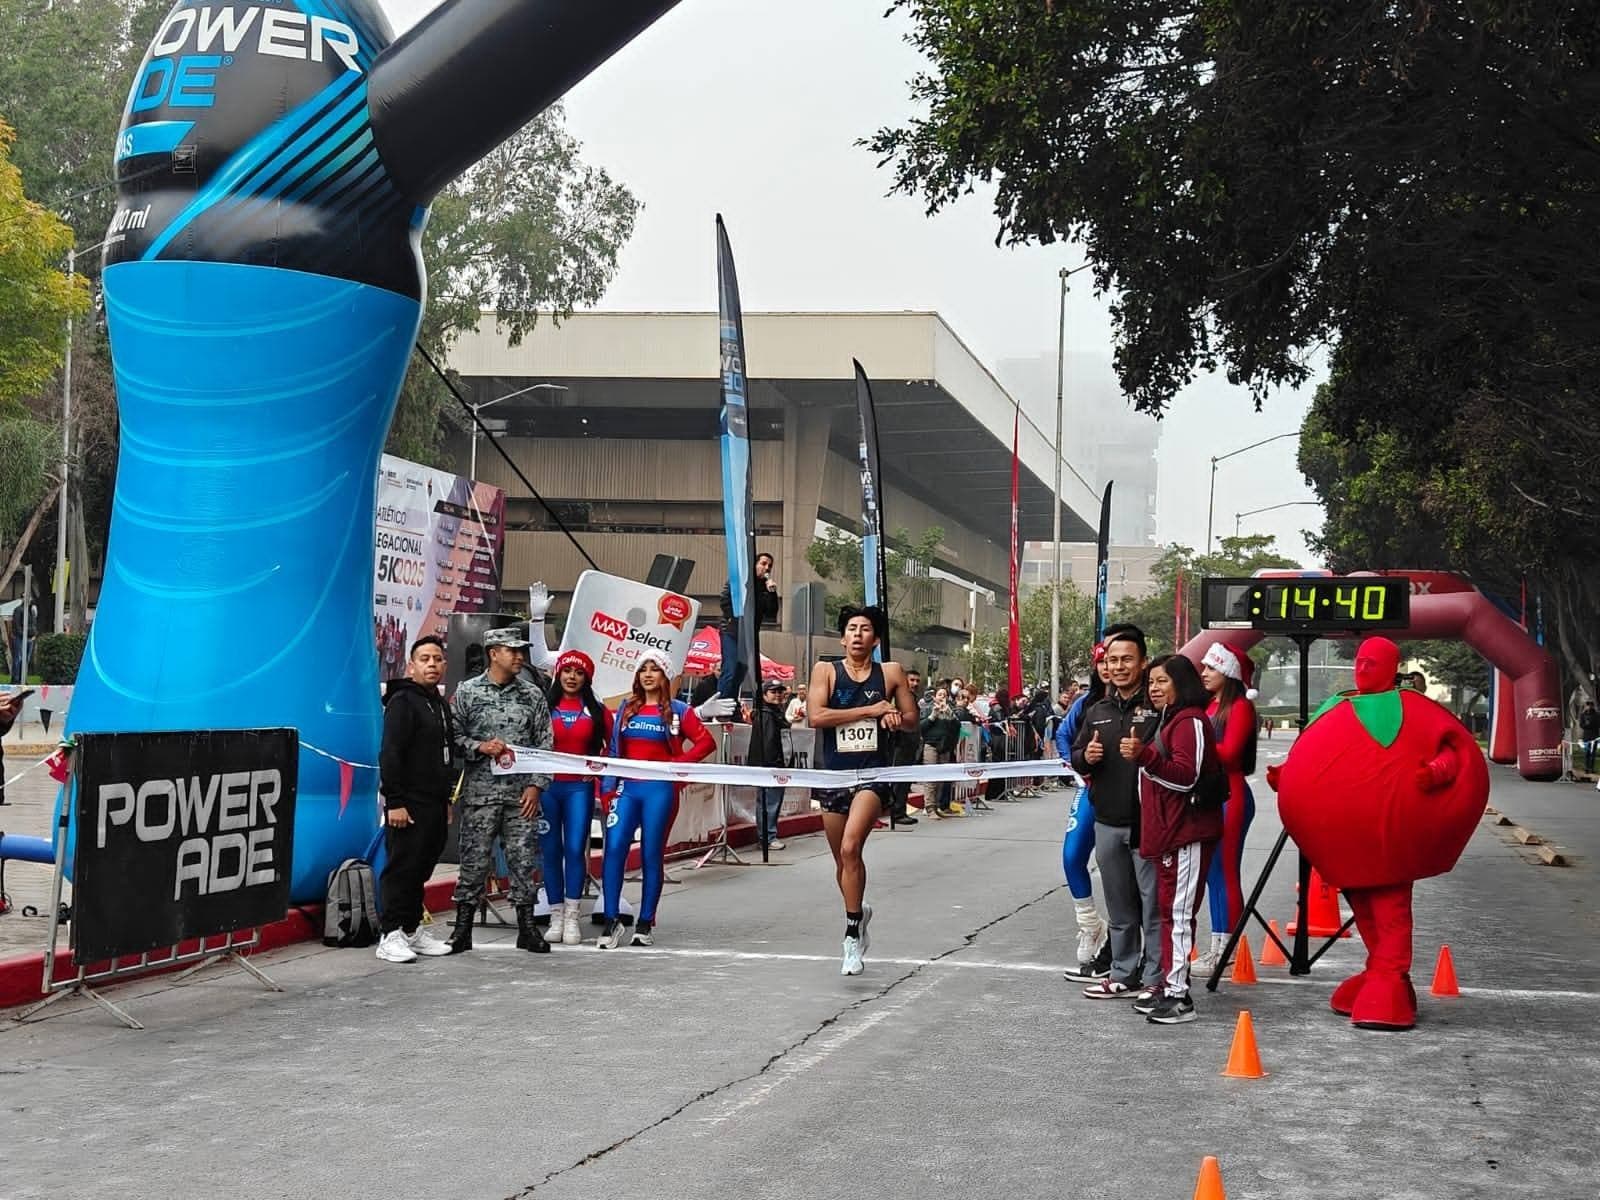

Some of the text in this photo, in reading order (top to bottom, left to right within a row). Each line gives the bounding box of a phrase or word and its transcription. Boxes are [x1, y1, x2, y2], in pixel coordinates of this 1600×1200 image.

[154, 7, 362, 73] OWER
[132, 55, 222, 112] DE
[377, 532, 422, 556] EGACIONAL
[591, 617, 673, 652] MAX Select
[600, 653, 636, 673] Ente
[607, 641, 641, 659] Lech
[561, 713, 577, 723] Cali
[840, 727, 874, 741] 1307
[97, 769, 281, 848] POWER
[174, 827, 276, 901] ADE
